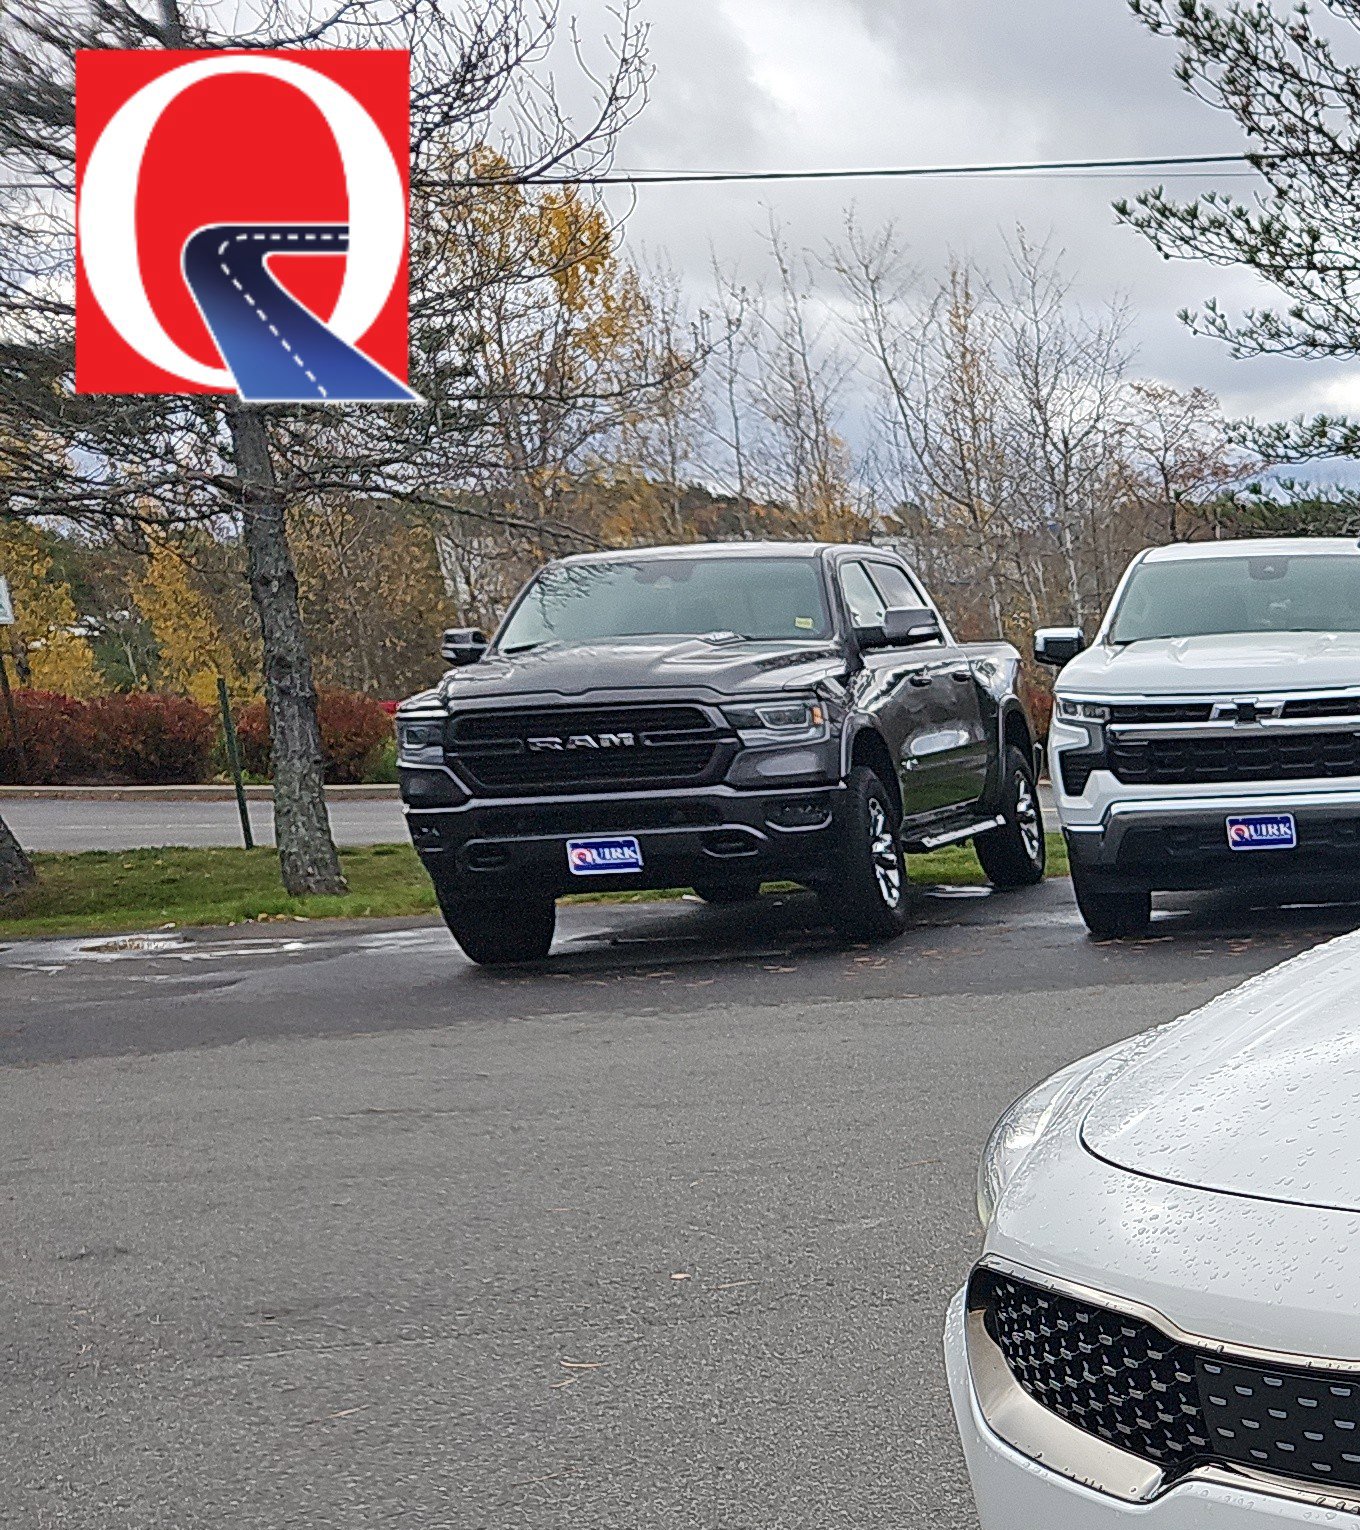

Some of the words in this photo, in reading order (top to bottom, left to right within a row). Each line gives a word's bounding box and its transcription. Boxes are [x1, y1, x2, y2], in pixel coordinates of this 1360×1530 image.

[526, 732, 635, 751] RAM
[1230, 822, 1292, 841] QUIRK
[571, 846, 639, 865] QUIRK
